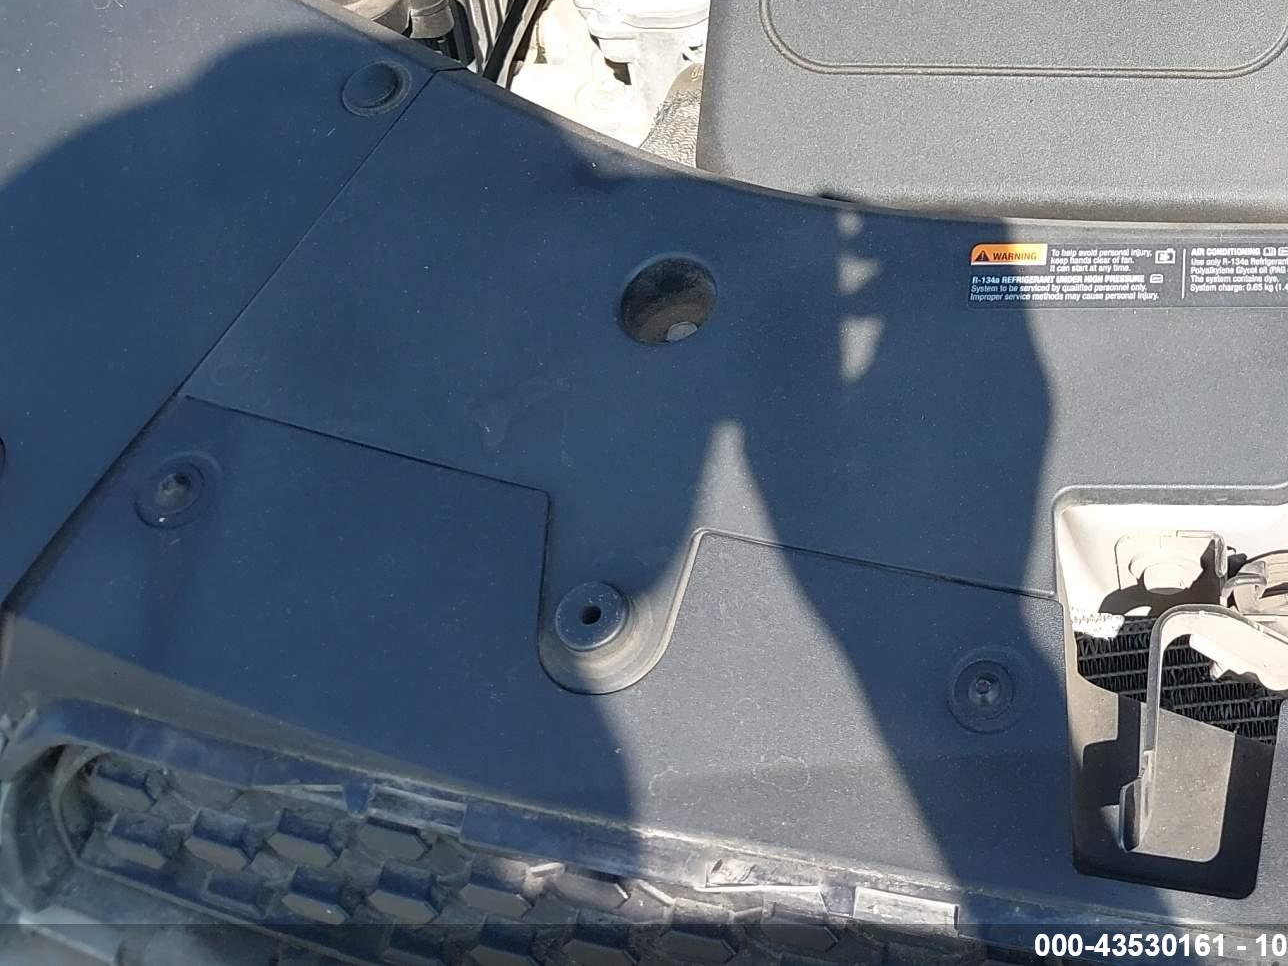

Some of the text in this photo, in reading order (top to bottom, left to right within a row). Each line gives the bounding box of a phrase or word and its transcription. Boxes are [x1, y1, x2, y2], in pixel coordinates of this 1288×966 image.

[1002, 275, 1055, 284] REFRIGERANT
[1056, 275, 1082, 283] UNDER
[1084, 275, 1104, 283] HIGH
[1105, 275, 1144, 283] PRESSURE
[1062, 284, 1092, 292] qualified
[1094, 284, 1130, 292] personnel
[1131, 284, 1147, 292] only.
[1190, 284, 1216, 292] System
[1218, 284, 1245, 292] charge:
[1265, 284, 1274, 292] kg
[1065, 293, 1081, 301] may
[1137, 292, 1159, 300] injury.
